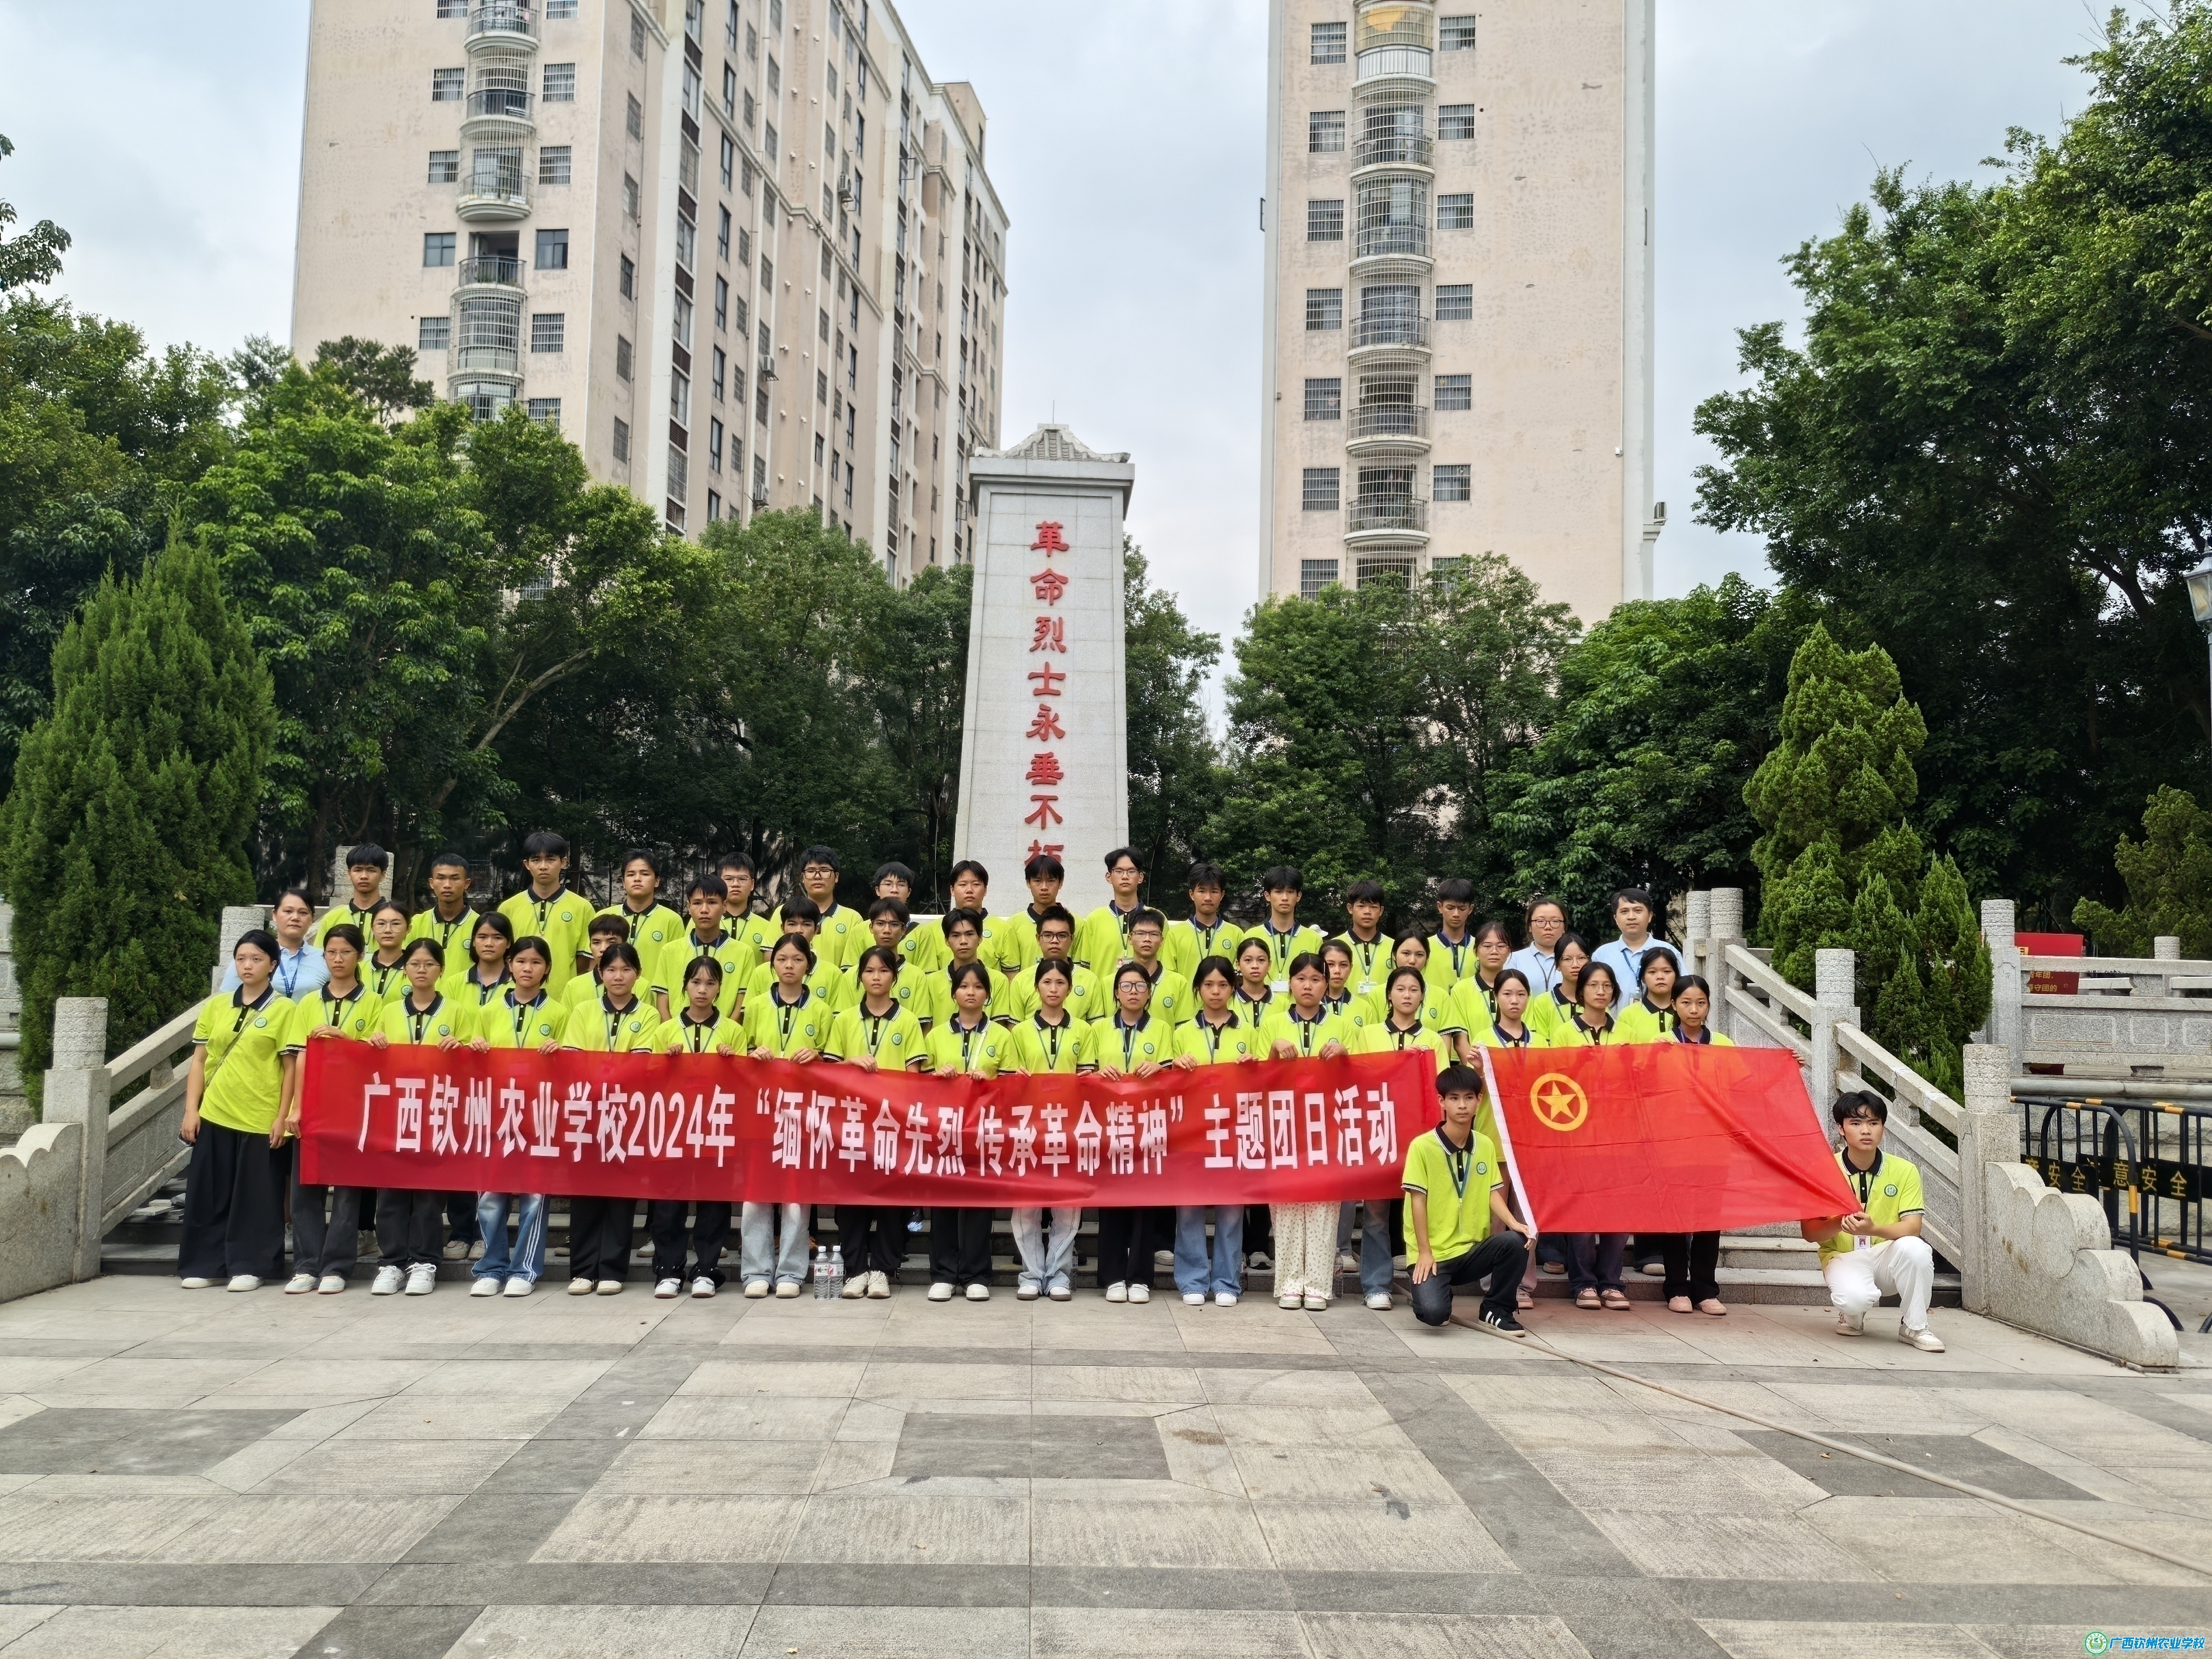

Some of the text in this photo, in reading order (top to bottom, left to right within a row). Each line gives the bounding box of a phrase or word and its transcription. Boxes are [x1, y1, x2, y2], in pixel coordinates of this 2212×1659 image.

[358, 1071, 736, 1168] 广西钦州农业学校2024年
[1204, 1082, 1397, 1171] 主题团日活动
